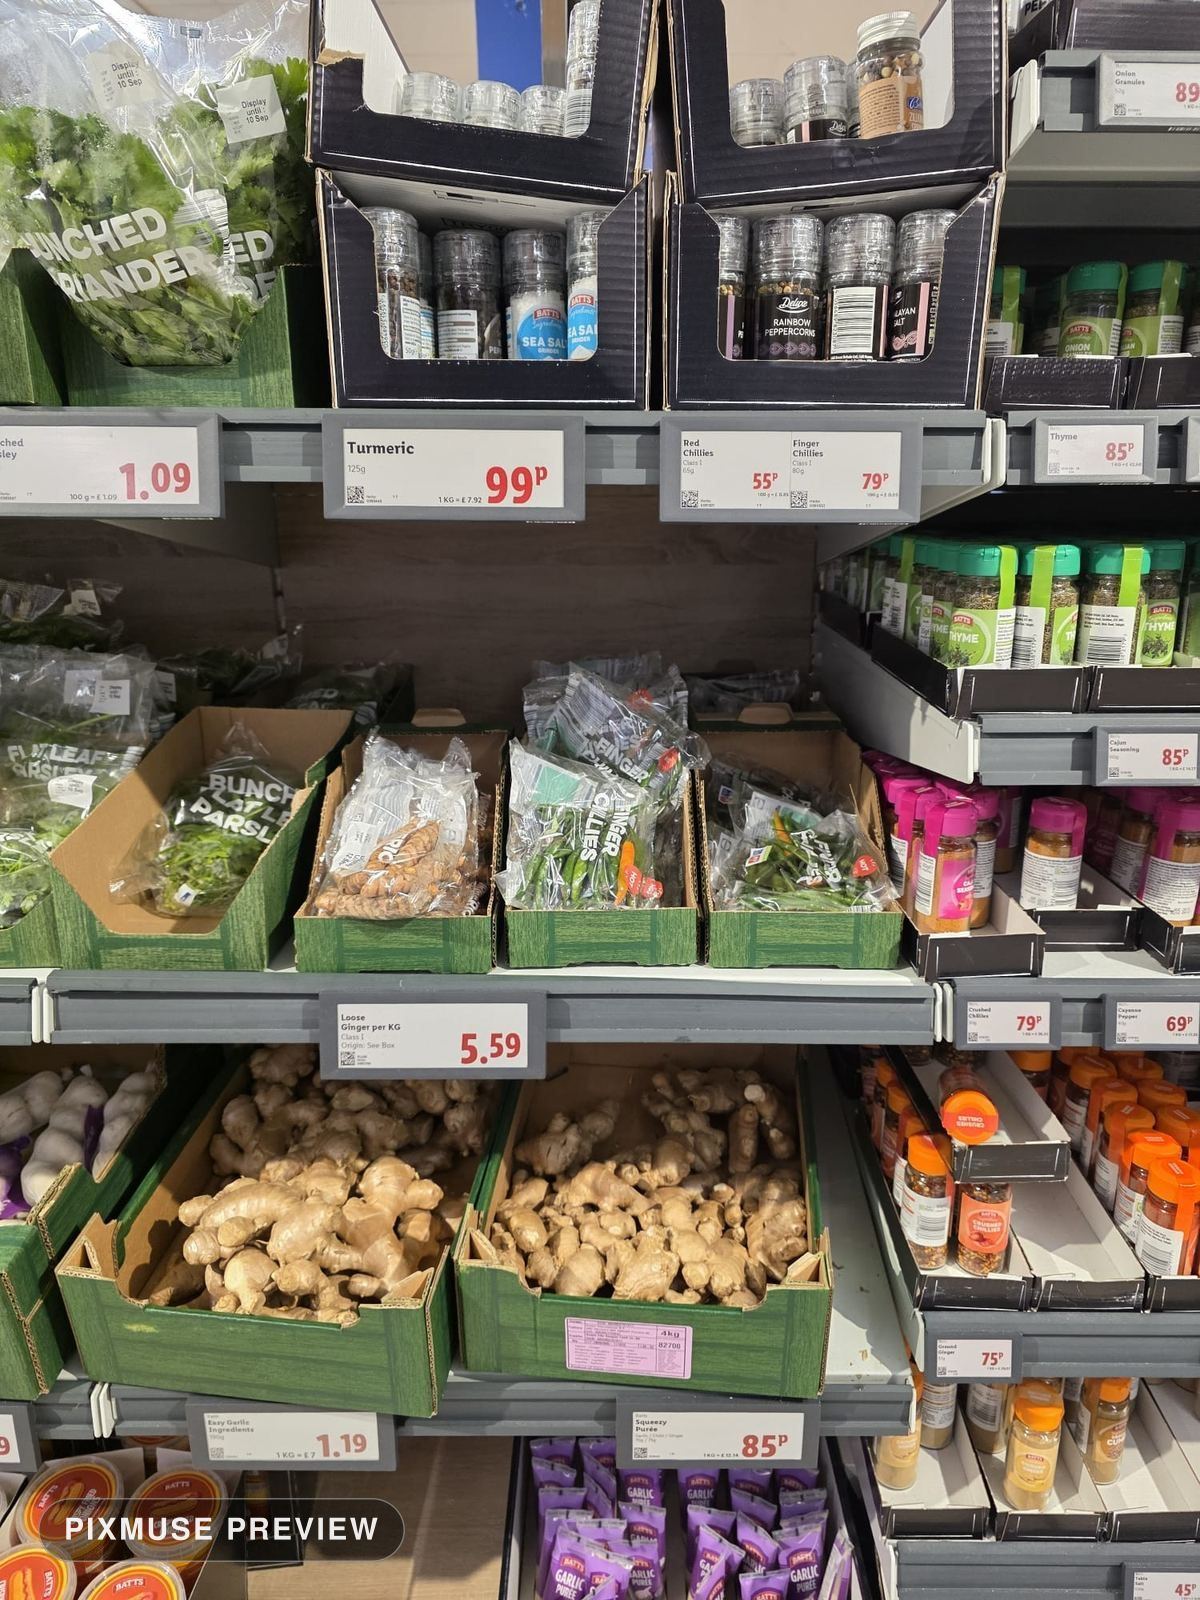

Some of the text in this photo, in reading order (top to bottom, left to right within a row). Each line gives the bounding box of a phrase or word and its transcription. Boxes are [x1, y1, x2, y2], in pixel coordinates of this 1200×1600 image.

[111, 61, 139, 73] Display
[117, 71, 134, 79] until
[117, 78, 142, 89] 10 Sep
[1115, 78, 1145, 86] Granules
[1175, 82, 1200, 103] 89
[241, 98, 267, 109] Display
[246, 107, 262, 116] until
[246, 114, 269, 125] 10 Sep
[778, 297, 808, 310] Deluxe
[536, 309, 560, 318] BATTS
[773, 318, 811, 327] RAINBOW
[764, 328, 815, 337] PEPPERCORNS
[522, 337, 546, 347] SEA
[1064, 344, 1090, 353] ONION
[683, 439, 700, 447] Red
[1050, 433, 1078, 442] Thyme
[347, 441, 415, 455] Turmeric
[793, 439, 820, 449] Finger
[683, 449, 714, 457] Chillies
[792, 449, 824, 458] Chillies
[1105, 442, 1134, 461] 85p
[347, 464, 366, 475] 125g
[119, 462, 191, 501] 1.09
[486, 465, 548, 504] 99p
[753, 472, 778, 490] 55p
[862, 472, 889, 490] 79p
[438, 496, 442, 504] 1
[443, 496, 454, 504] KG
[461, 496, 466, 504] £
[467, 496, 482, 504] 7.92
[1162, 748, 1189, 766] 85p
[629, 870, 638, 888] HOT
[341, 1014, 366, 1022] Loose
[1016, 1015, 1042, 1031] 79p
[341, 1023, 401, 1033] Ginger per KG
[1166, 1016, 1193, 1032] 69p
[341, 1033, 359, 1041] Class
[341, 1041, 395, 1050] Origin: See Box
[460, 1032, 521, 1065] 5.59
[981, 1352, 1003, 1366] 75p
[316, 1433, 368, 1458] 1.19
[741, 1434, 788, 1458] 85p
[282, 1451, 295, 1459] KG
[164, 1480, 191, 1491] BATTS
[627, 1486, 655, 1499] GARLIC
[687, 1489, 714, 1500] GARLIC
[790, 1564, 820, 1583] GARLIC
[115, 1578, 145, 1592] BATTS
[555, 1569, 585, 1592] GARLIC
[1174, 1583, 1197, 1597] 45p
